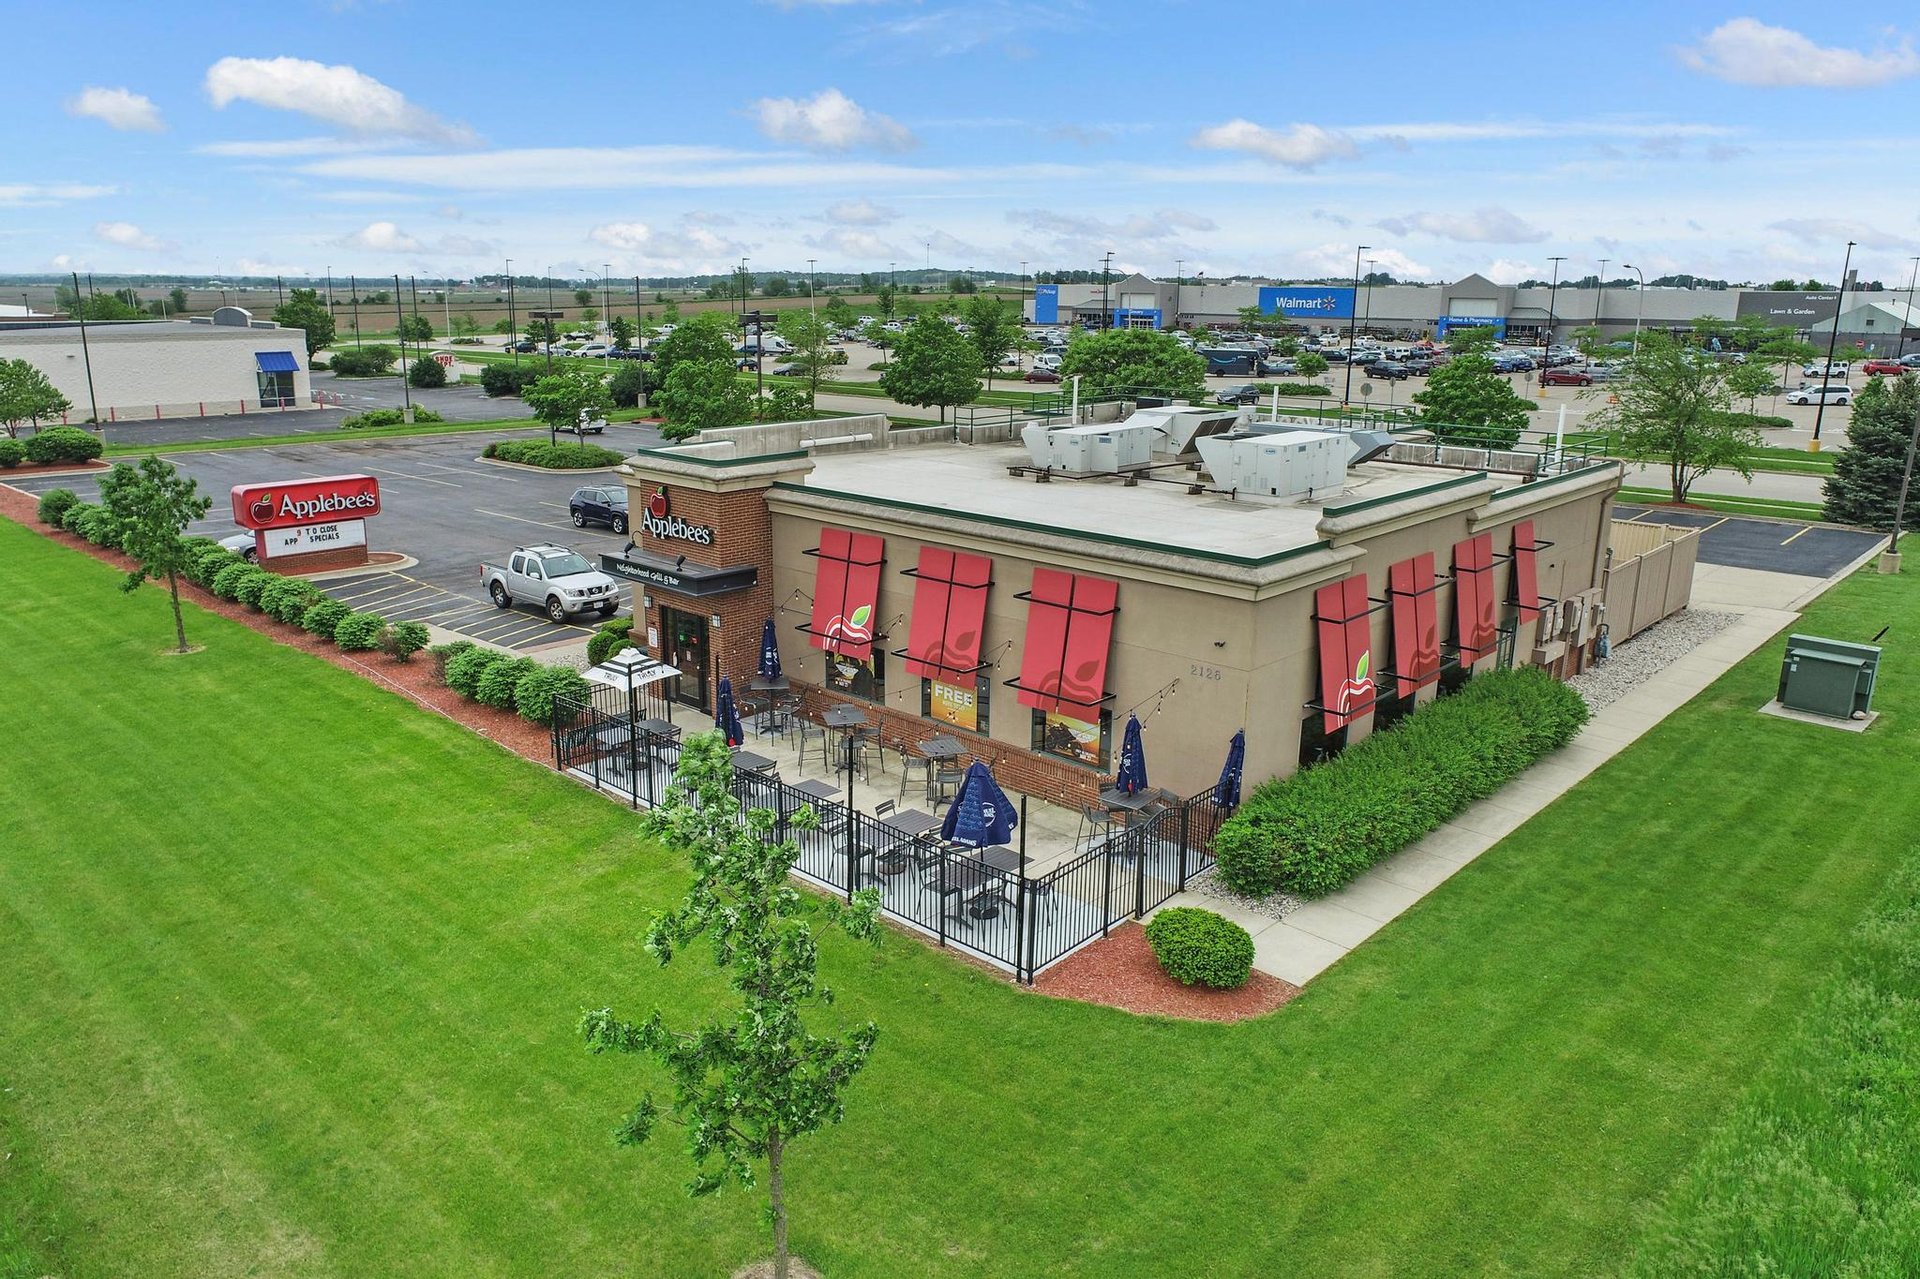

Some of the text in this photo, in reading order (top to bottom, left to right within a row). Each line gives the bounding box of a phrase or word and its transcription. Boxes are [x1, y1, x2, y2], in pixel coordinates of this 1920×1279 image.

[1276, 297, 1321, 309] Walmart
[279, 492, 375, 518] Applebee's
[320, 524, 338, 534] CLOSE
[641, 507, 710, 545] Applebee's
[284, 533, 339, 546] APP SPECIALS
[616, 563, 650, 578] Neighborhood
[650, 571, 663, 582] Grill
[1190, 664, 1222, 681] 2126
[935, 684, 973, 707] FREE
